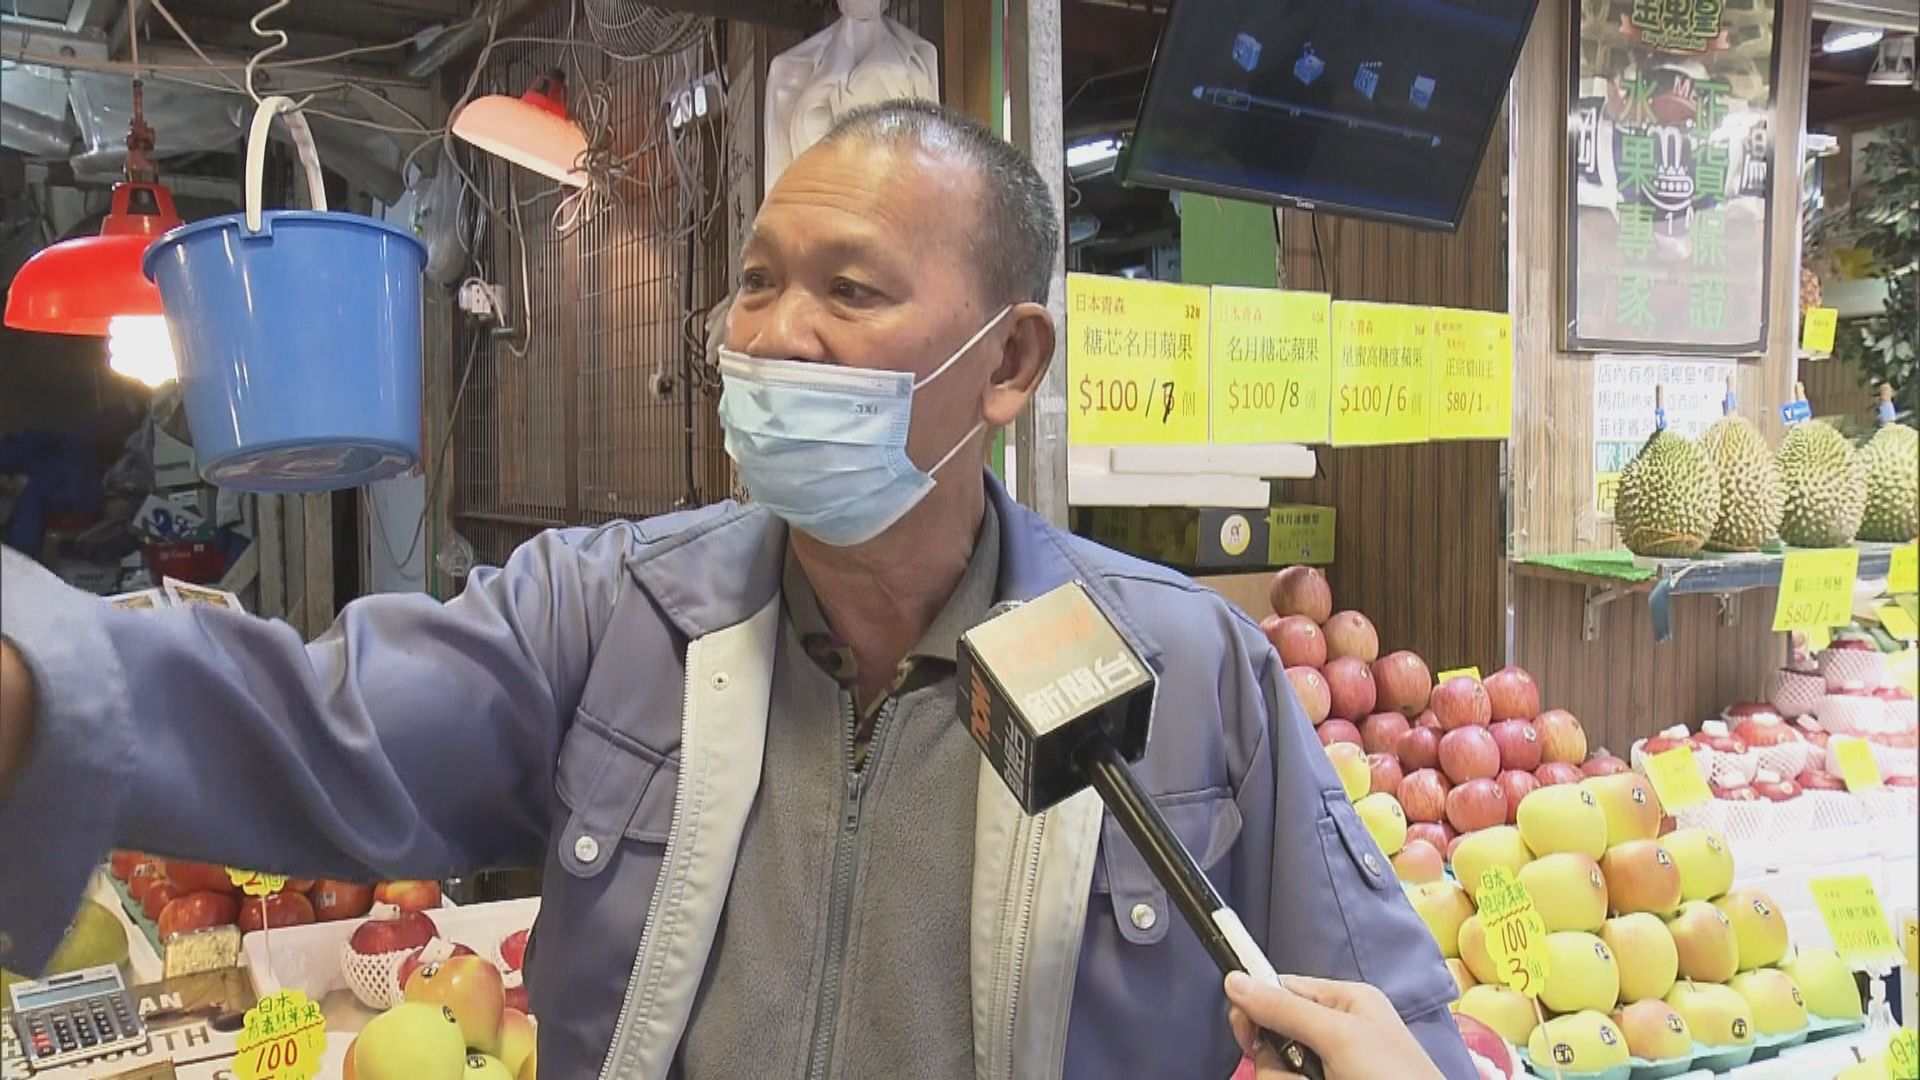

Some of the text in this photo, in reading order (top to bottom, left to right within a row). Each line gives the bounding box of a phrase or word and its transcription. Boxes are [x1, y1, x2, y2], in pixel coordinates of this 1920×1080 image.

[1617, 69, 1658, 333] 水果專家
[1688, 79, 1732, 331] 正貨保證
[1076, 293, 1126, 314] 日本青森
[1083, 325, 1193, 361] 糖芯名月蘋果
[1227, 335, 1320, 363] 名月糖芯蘋果
[1022, 650, 1142, 729] 新聞台
[1003, 714, 1027, 801] 新聞台
[255, 1038, 298, 1074] 100
